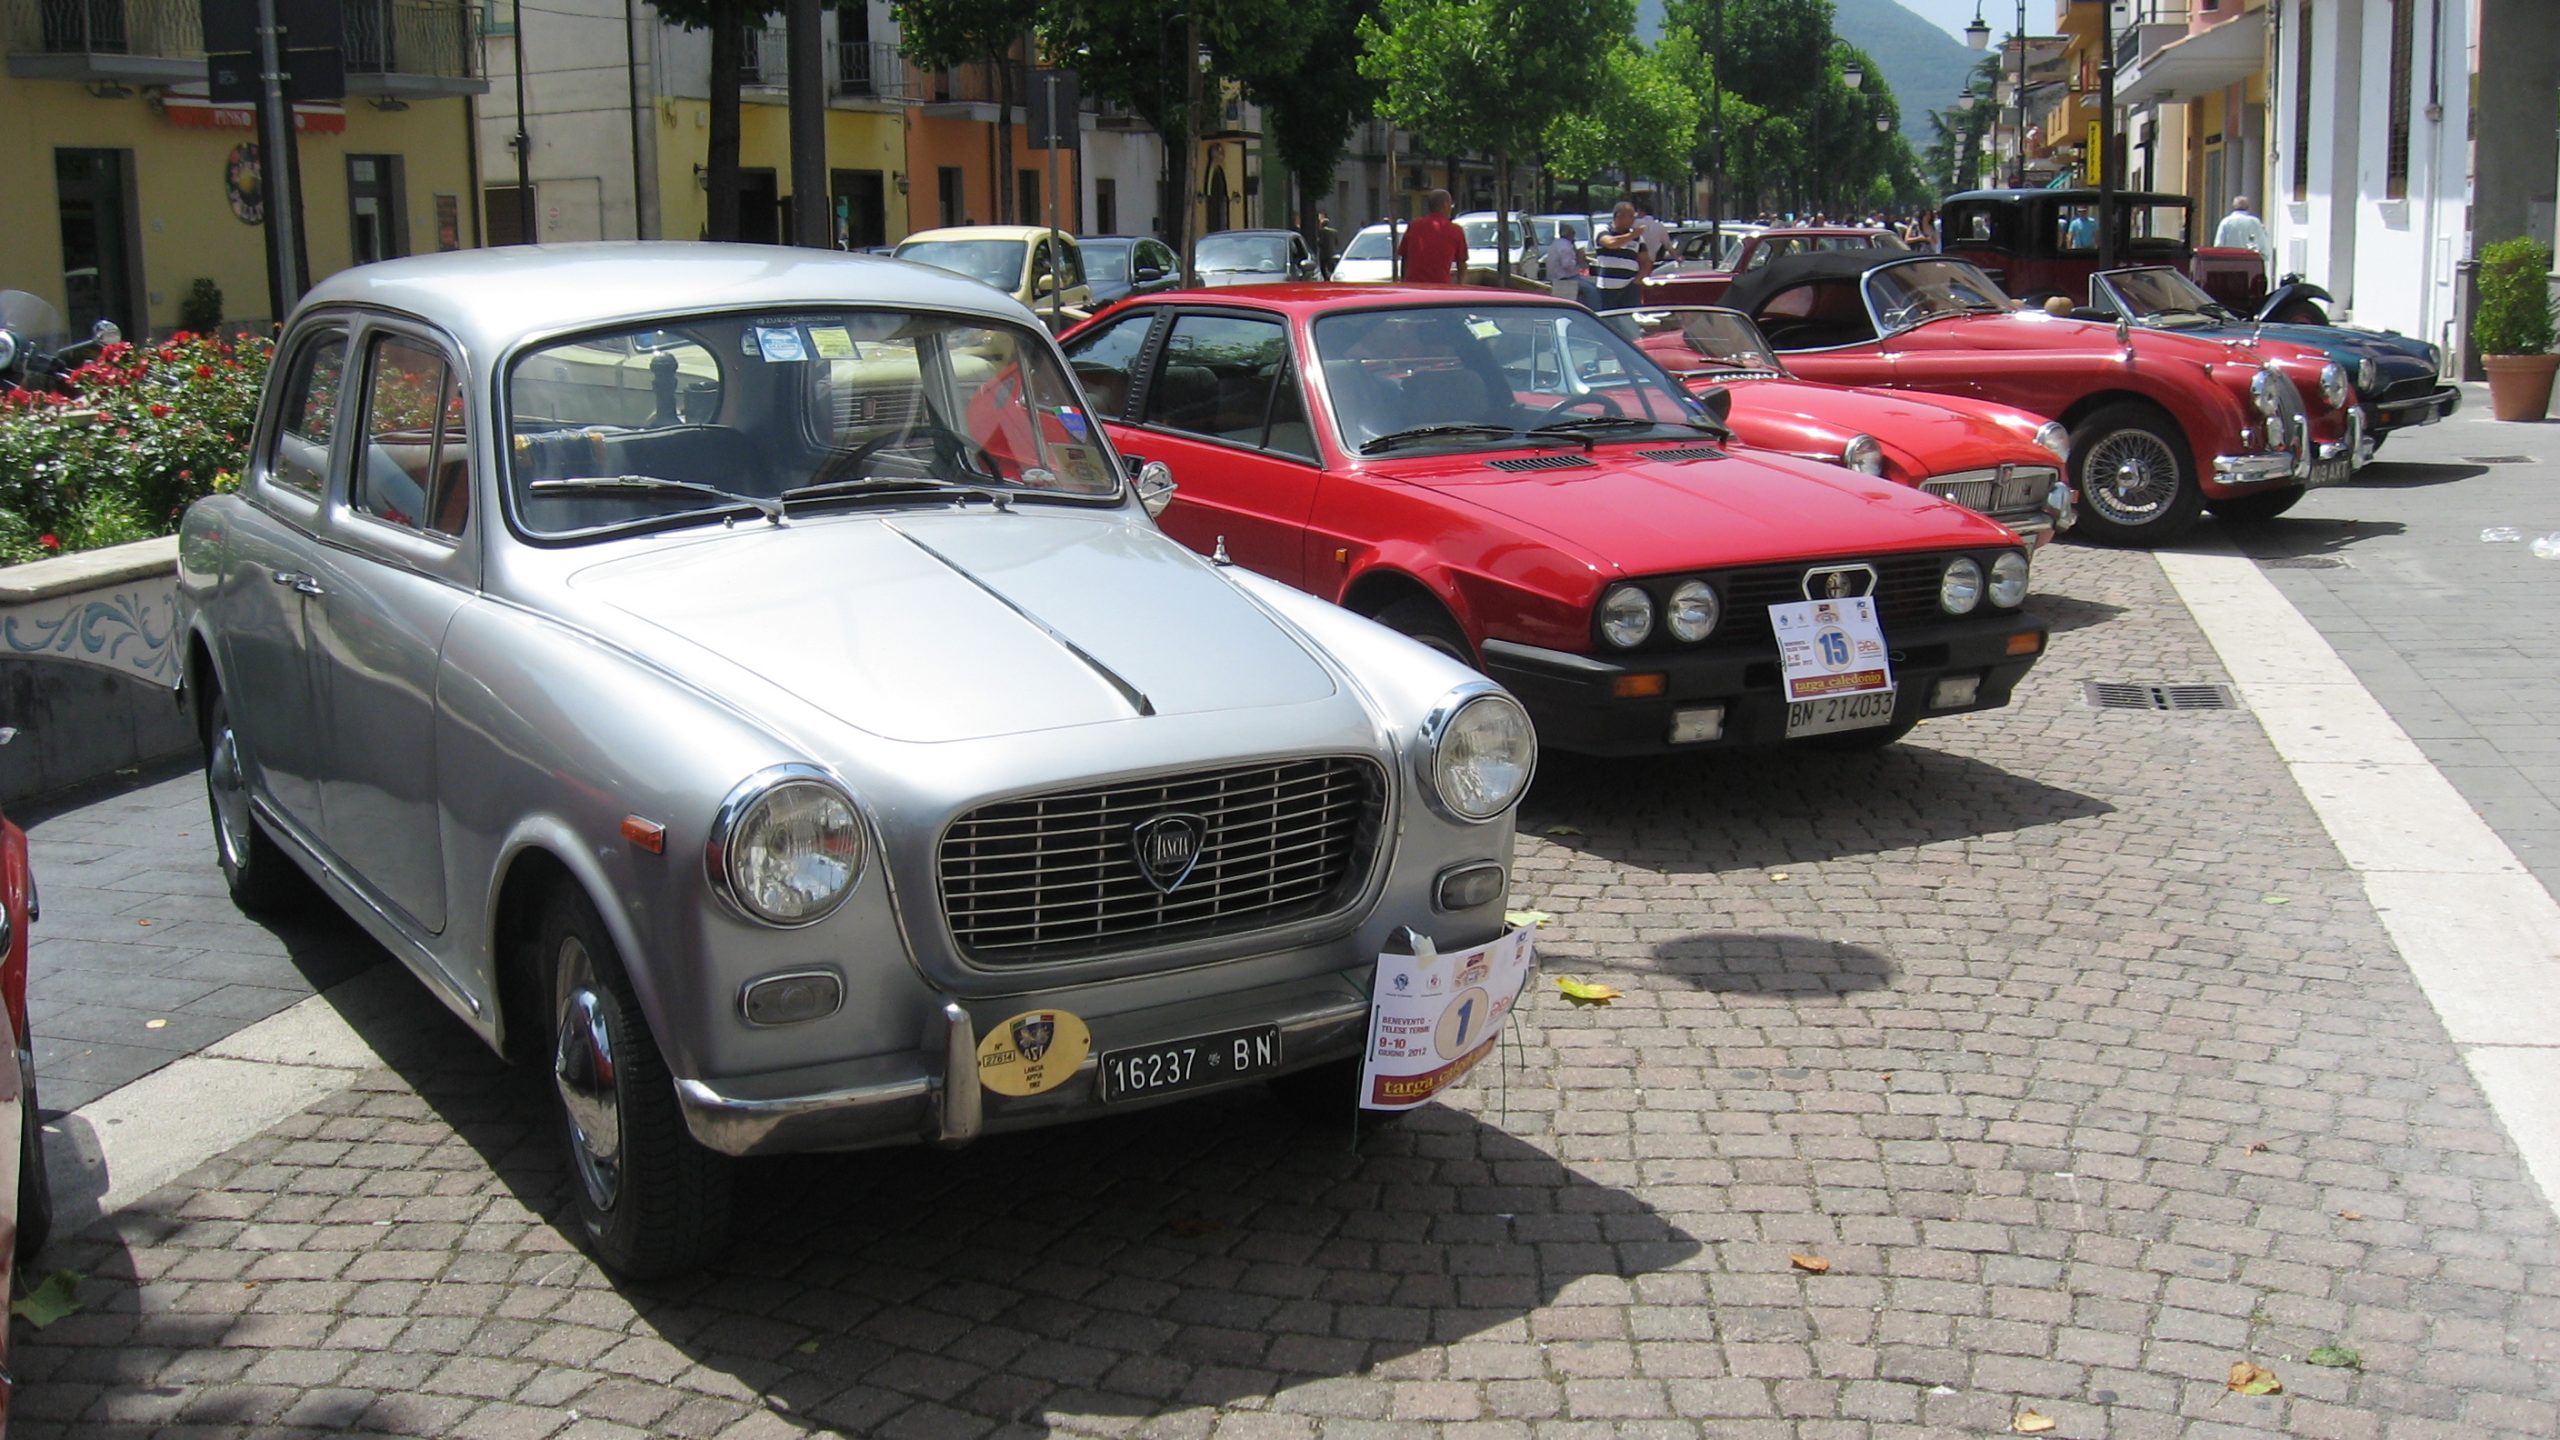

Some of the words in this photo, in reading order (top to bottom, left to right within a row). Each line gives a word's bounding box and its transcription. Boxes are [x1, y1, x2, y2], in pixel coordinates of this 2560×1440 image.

[1818, 632, 1850, 666] 15
[1790, 701, 1815, 727] BN
[1825, 693, 1894, 722] 214033
[1456, 998, 1474, 1047] 1
[1379, 1036, 1406, 1049] 9-10
[1408, 1047, 1427, 1057] 2012
[1115, 1048, 1197, 1093] 16237
[1234, 1034, 1271, 1071] BN
[1384, 1077, 1434, 1097] targa
